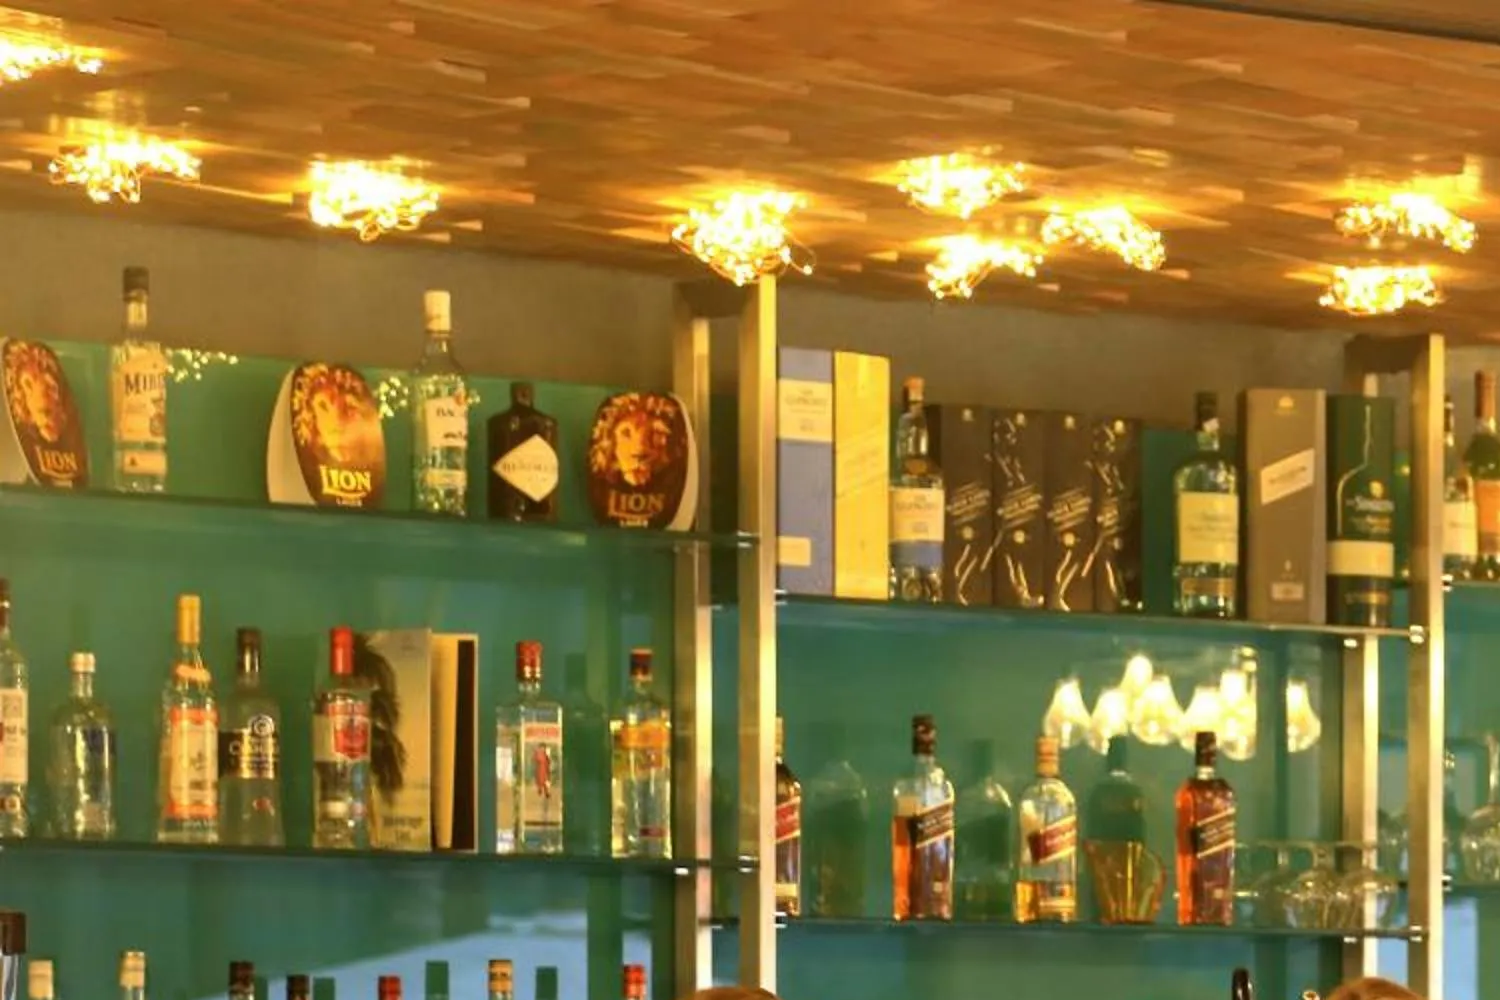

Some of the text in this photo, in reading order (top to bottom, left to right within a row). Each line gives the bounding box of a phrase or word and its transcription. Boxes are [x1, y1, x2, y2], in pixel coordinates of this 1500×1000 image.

[35, 445, 78, 478] LION
[320, 465, 372, 497] LION
[608, 489, 665, 519] LION
